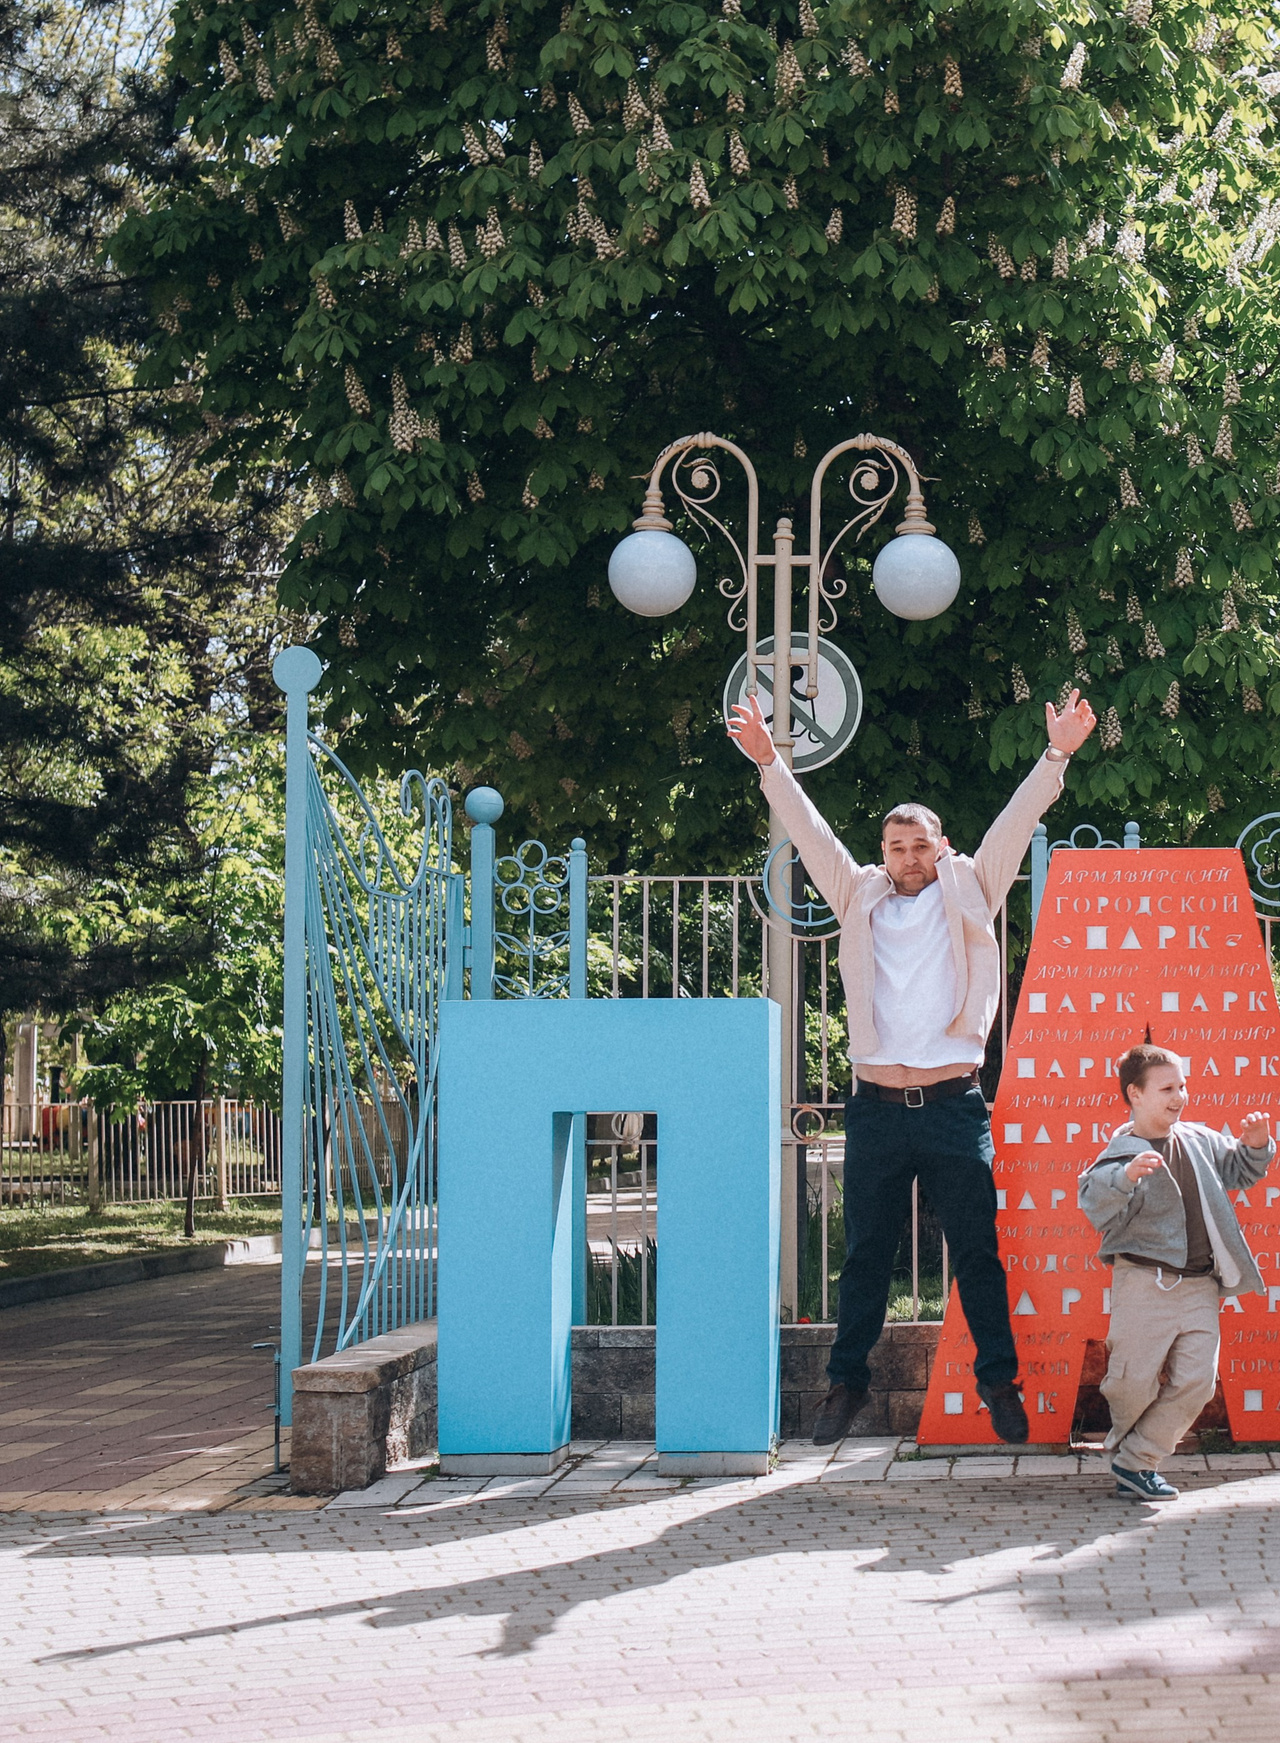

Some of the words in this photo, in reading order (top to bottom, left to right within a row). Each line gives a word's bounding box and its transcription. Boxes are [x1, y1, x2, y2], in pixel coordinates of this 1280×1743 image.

[1060, 867, 1231, 885] АРМАВИРСКИЙ
[1056, 893, 1238, 917] ГОРОДСКОЙ
[1085, 926, 1211, 950] ПАРК
[1033, 964, 1139, 981] АРМАВИР
[1156, 963, 1261, 980] АРМАВИР
[1028, 992, 1136, 1014] ПАРК
[1160, 991, 1268, 1013] ПАРК
[1019, 1028, 1133, 1045] АРМАВИР
[1163, 1026, 1276, 1043] АРМАВИР
[1006, 1093, 1119, 1110] АРМАВИР
[1003, 1122, 1112, 1144] ПАРК
[992, 1158, 1092, 1175] АРМАВИ
[996, 1188, 1082, 1210] ПАР
